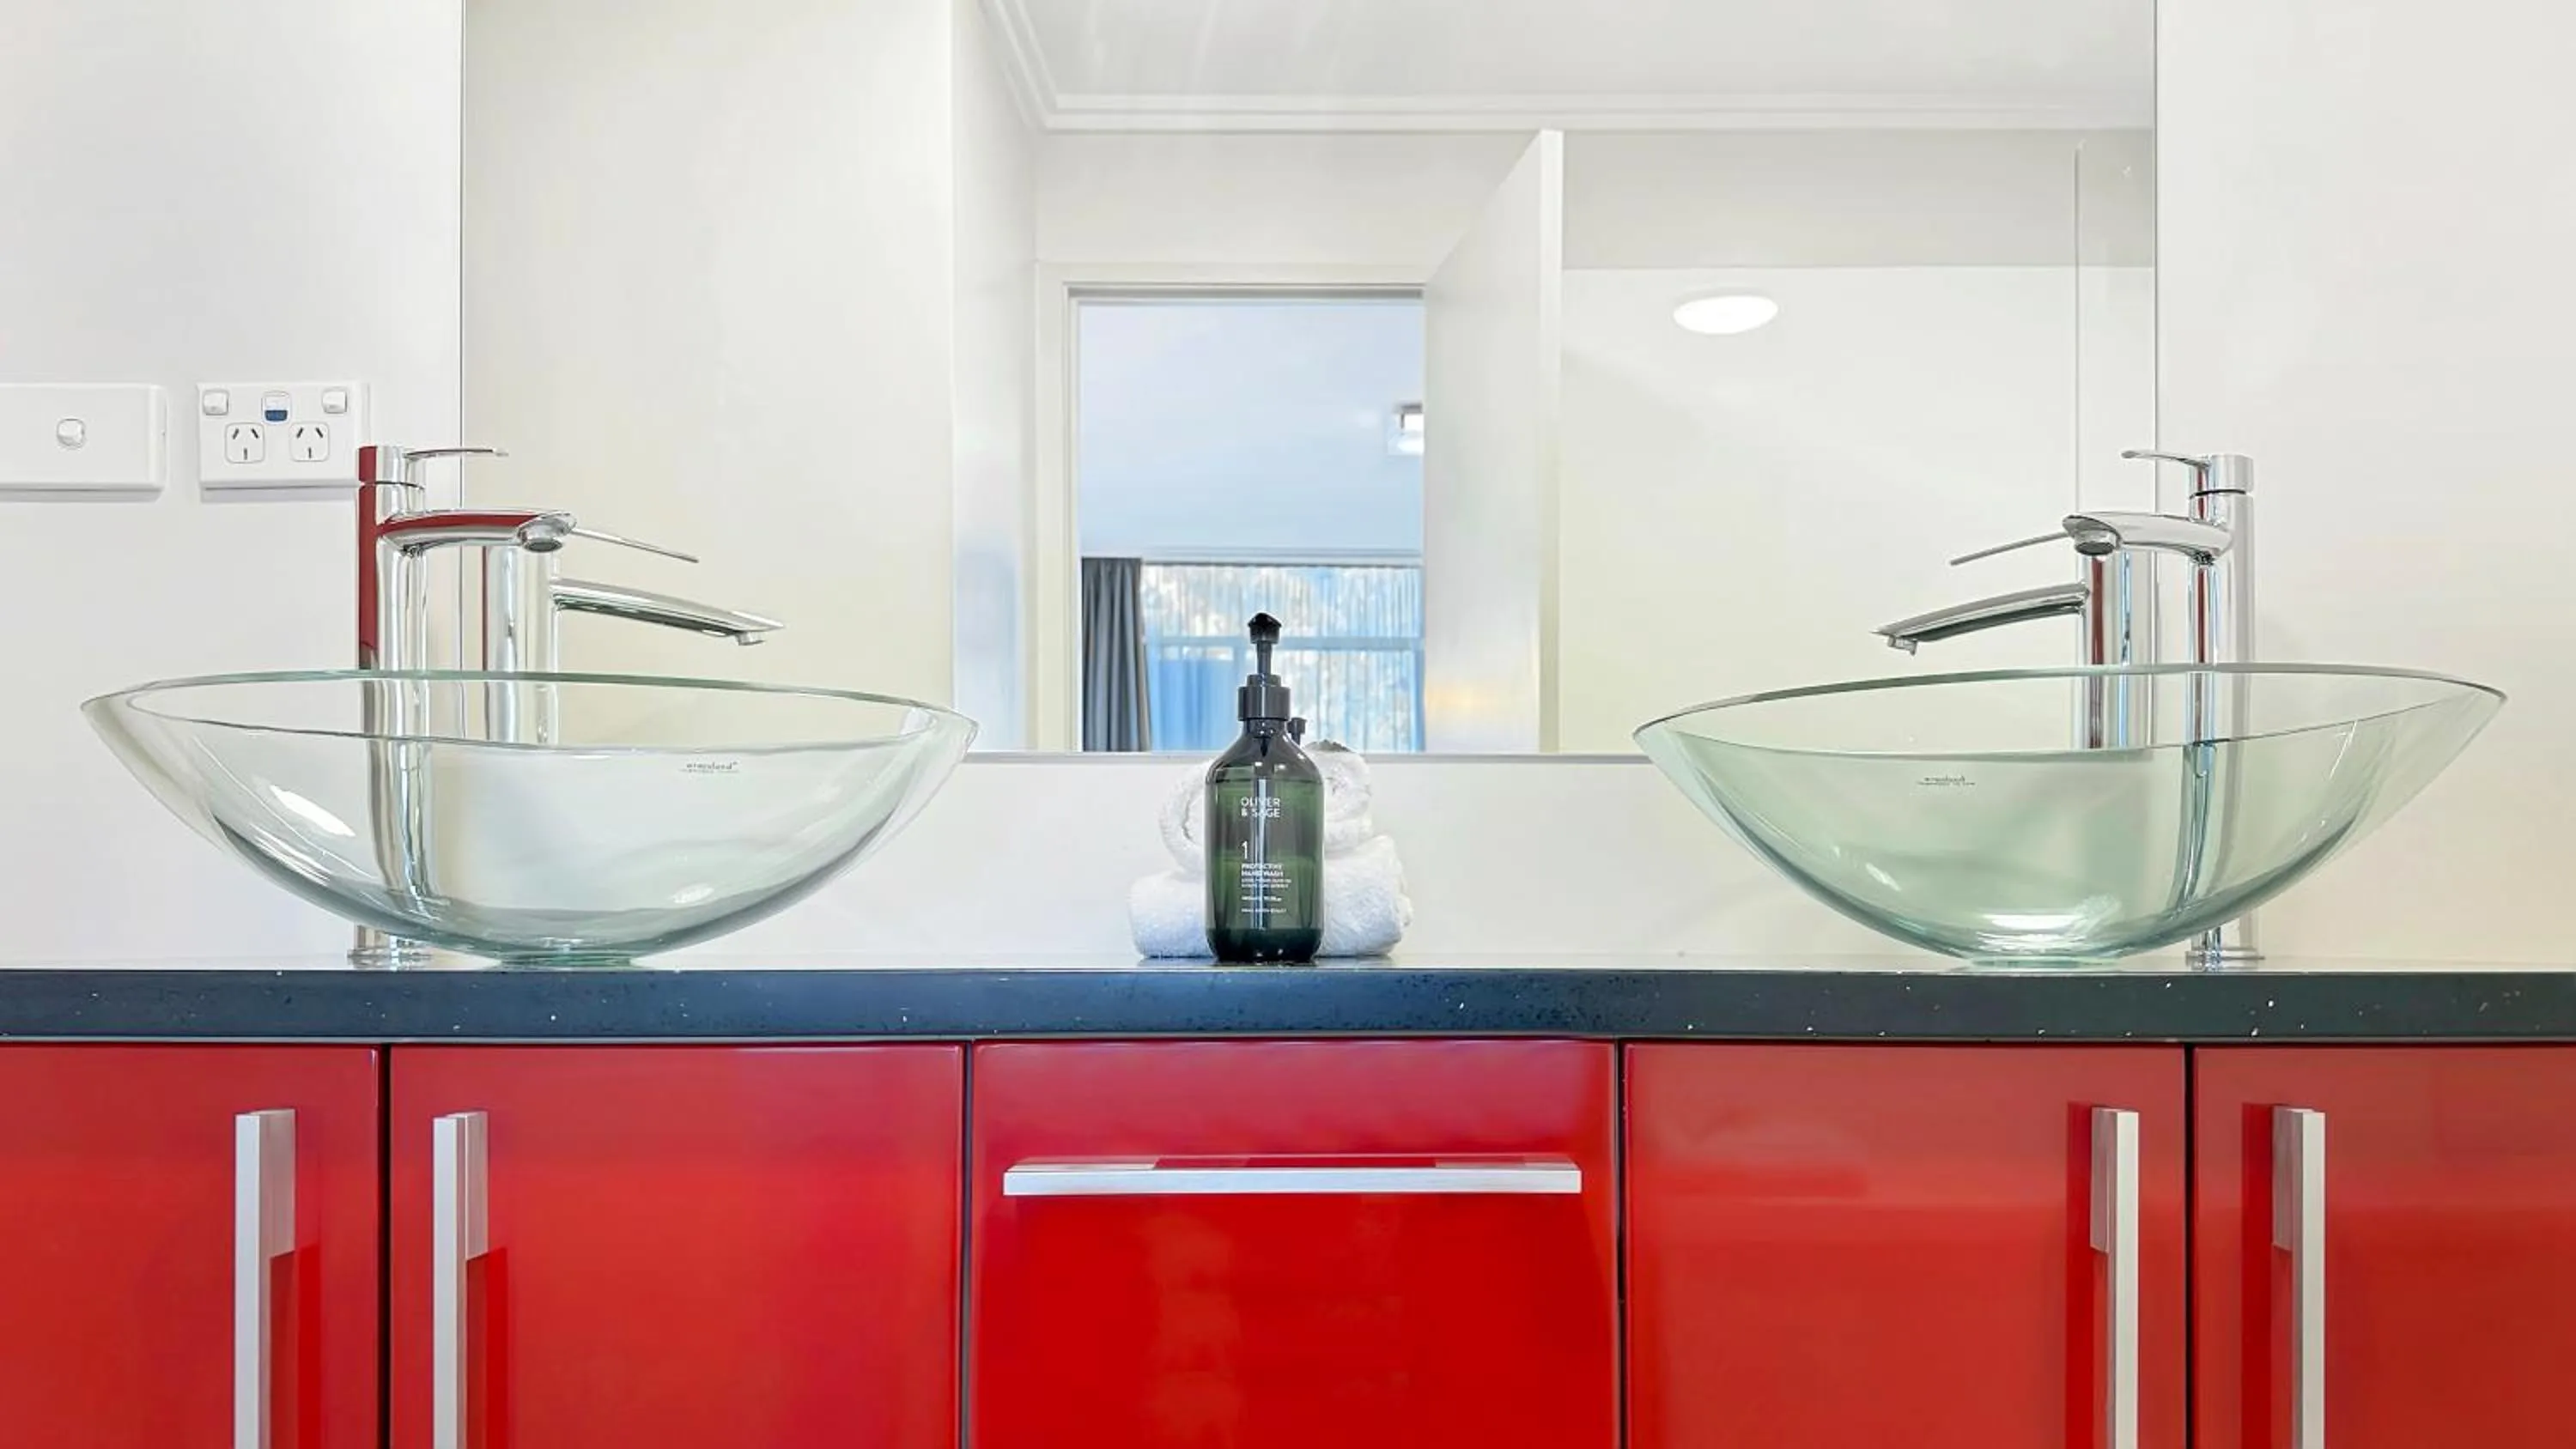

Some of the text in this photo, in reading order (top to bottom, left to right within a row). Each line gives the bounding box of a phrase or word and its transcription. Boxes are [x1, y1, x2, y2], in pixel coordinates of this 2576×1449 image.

[1241, 797, 1281, 807] OLIVER
[1252, 808, 1281, 818] SAGE
[1242, 840, 1249, 859] 1
